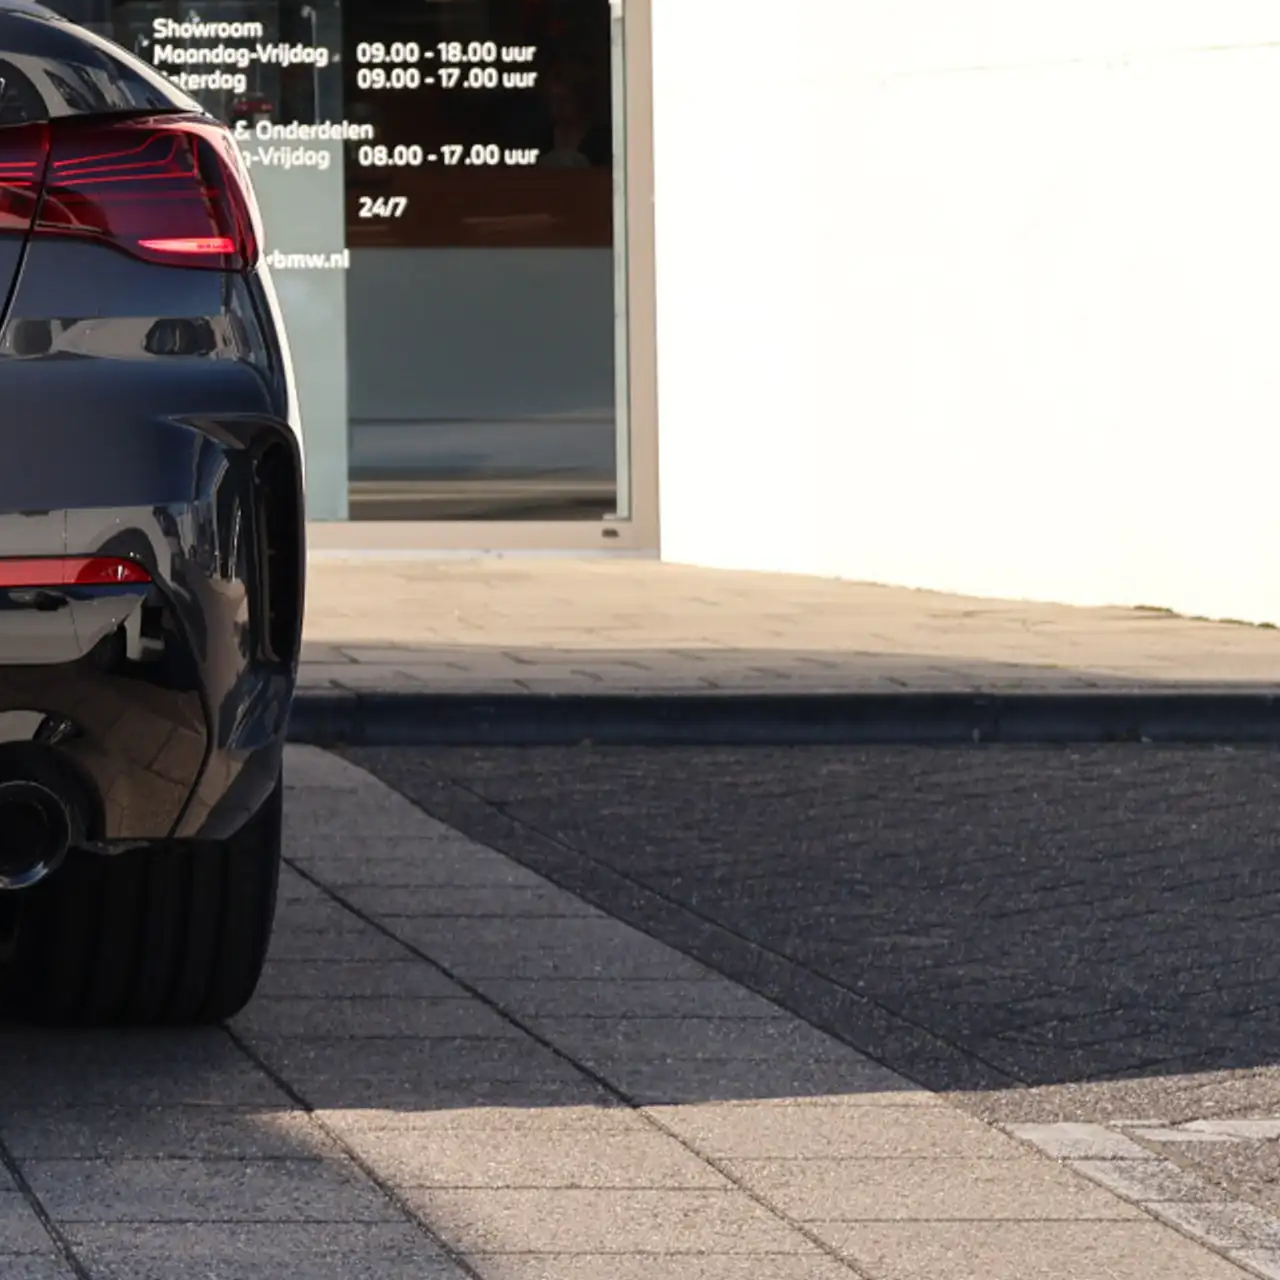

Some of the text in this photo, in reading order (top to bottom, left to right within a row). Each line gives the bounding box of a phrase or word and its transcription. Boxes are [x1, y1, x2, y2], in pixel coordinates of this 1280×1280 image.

[152, 17, 263, 39] Showroom
[153, 43, 329, 68] Maandag-Vrijdag
[356, 42, 421, 63] 09.00
[437, 41, 498, 62] 18.00
[501, 46, 537, 62] uur
[357, 68, 421, 89] 09.00
[502, 72, 538, 88] uur
[255, 120, 375, 141] Onderdelen
[358, 145, 423, 167] 08.00
[504, 149, 540, 165] uur
[358, 196, 409, 218] 24/7
